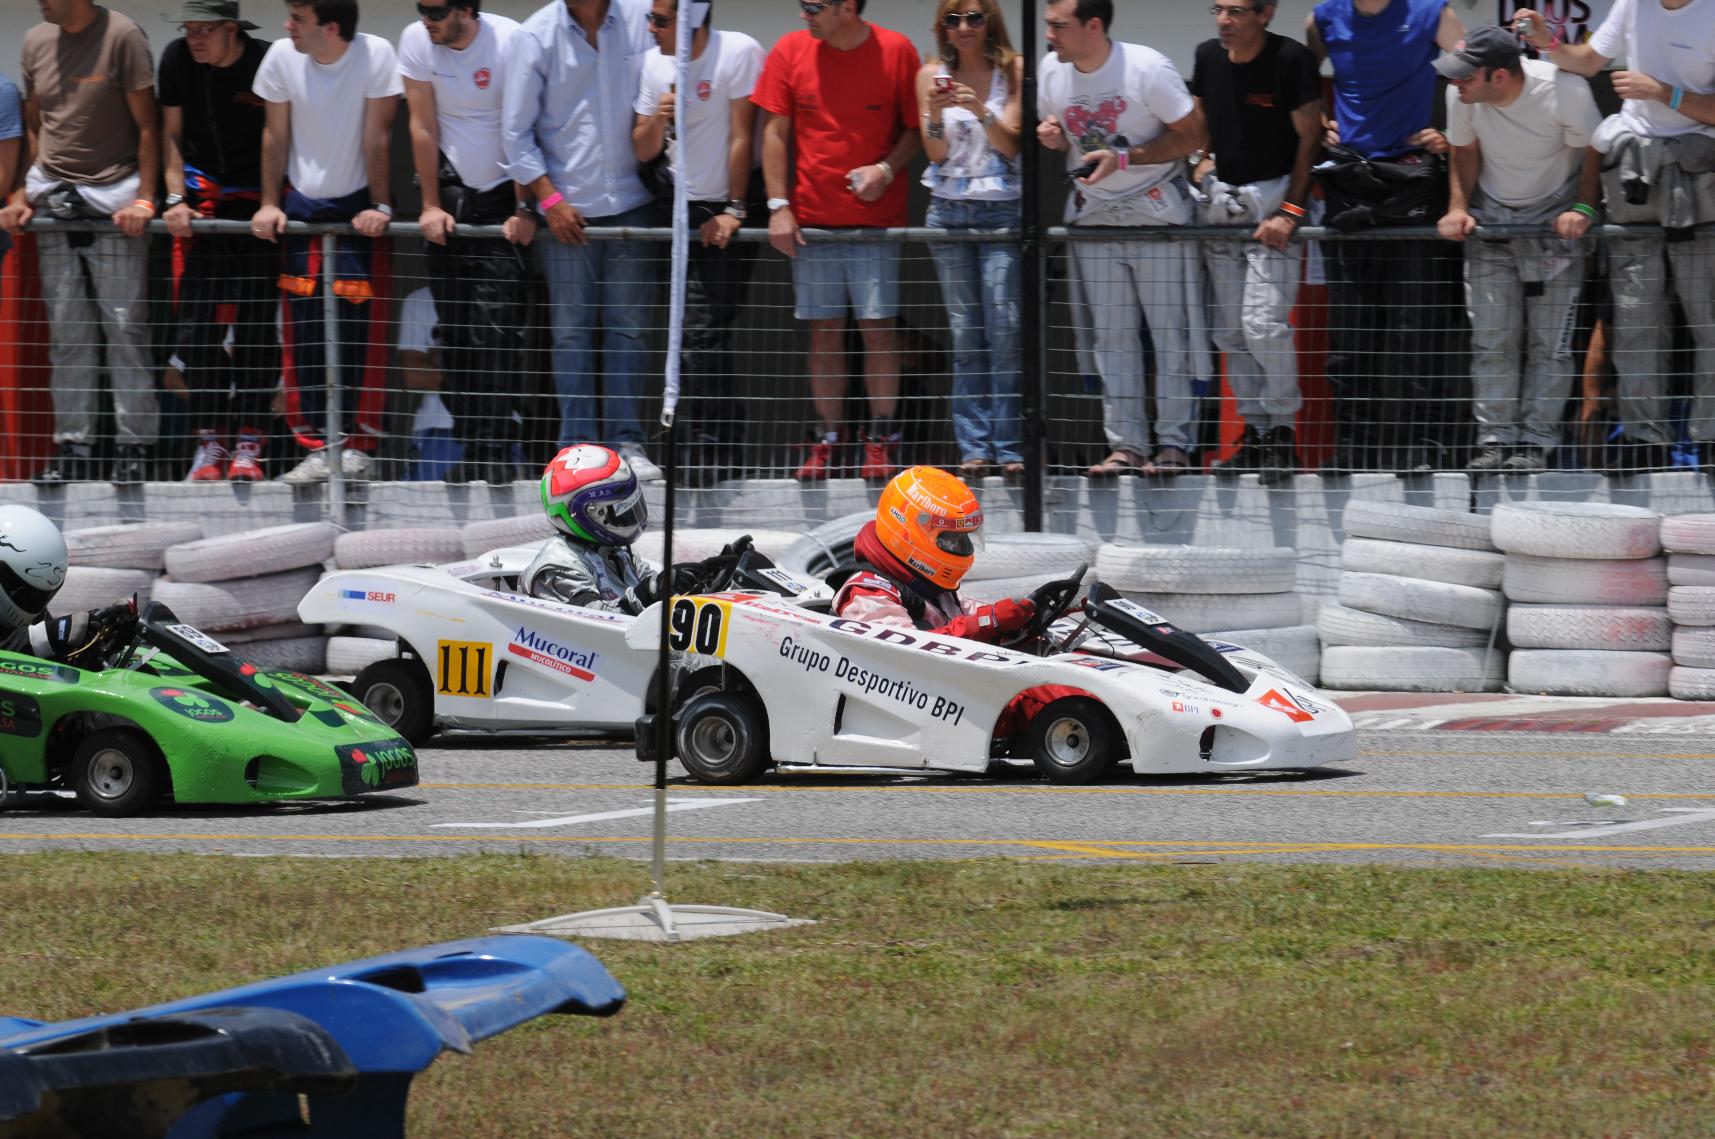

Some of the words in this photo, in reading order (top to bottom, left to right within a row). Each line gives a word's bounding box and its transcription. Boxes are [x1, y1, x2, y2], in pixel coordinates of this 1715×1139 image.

[906, 482, 948, 517] Marlboro
[908, 558, 935, 576] Marlboro
[368, 591, 395, 603] SEUR
[514, 627, 596, 670] Mucoral
[669, 598, 723, 656] 90
[440, 645, 488, 695] 111
[779, 635, 830, 673] Grupo
[834, 656, 928, 710] Desportivo
[930, 696, 965, 727] BPI
